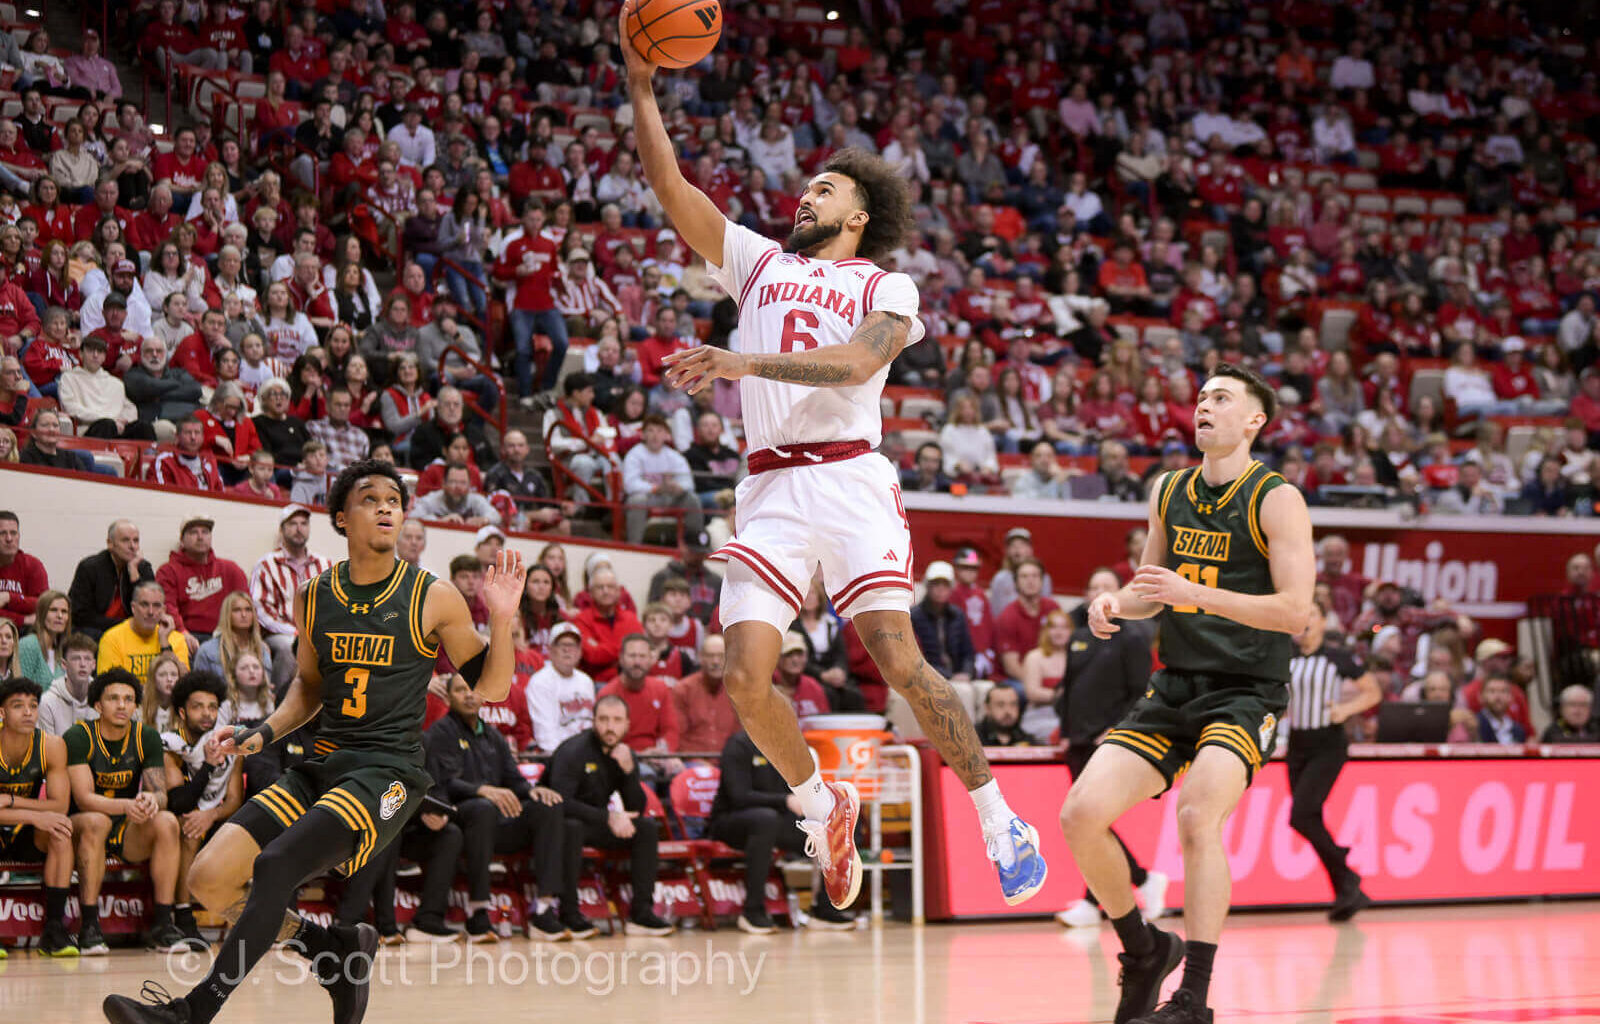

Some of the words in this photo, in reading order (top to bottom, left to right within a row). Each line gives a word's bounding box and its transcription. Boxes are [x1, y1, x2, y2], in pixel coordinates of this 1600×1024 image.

[757, 282, 856, 327] INDIANA
[780, 308, 819, 354] 6
[1175, 529, 1228, 559] SIENA
[1362, 540, 1498, 603] Union
[333, 634, 391, 664] SIENA
[341, 667, 370, 718] 3
[850, 740, 871, 765] G
[1152, 781, 1439, 882] LUCAS
[1459, 781, 1586, 875] OIL
